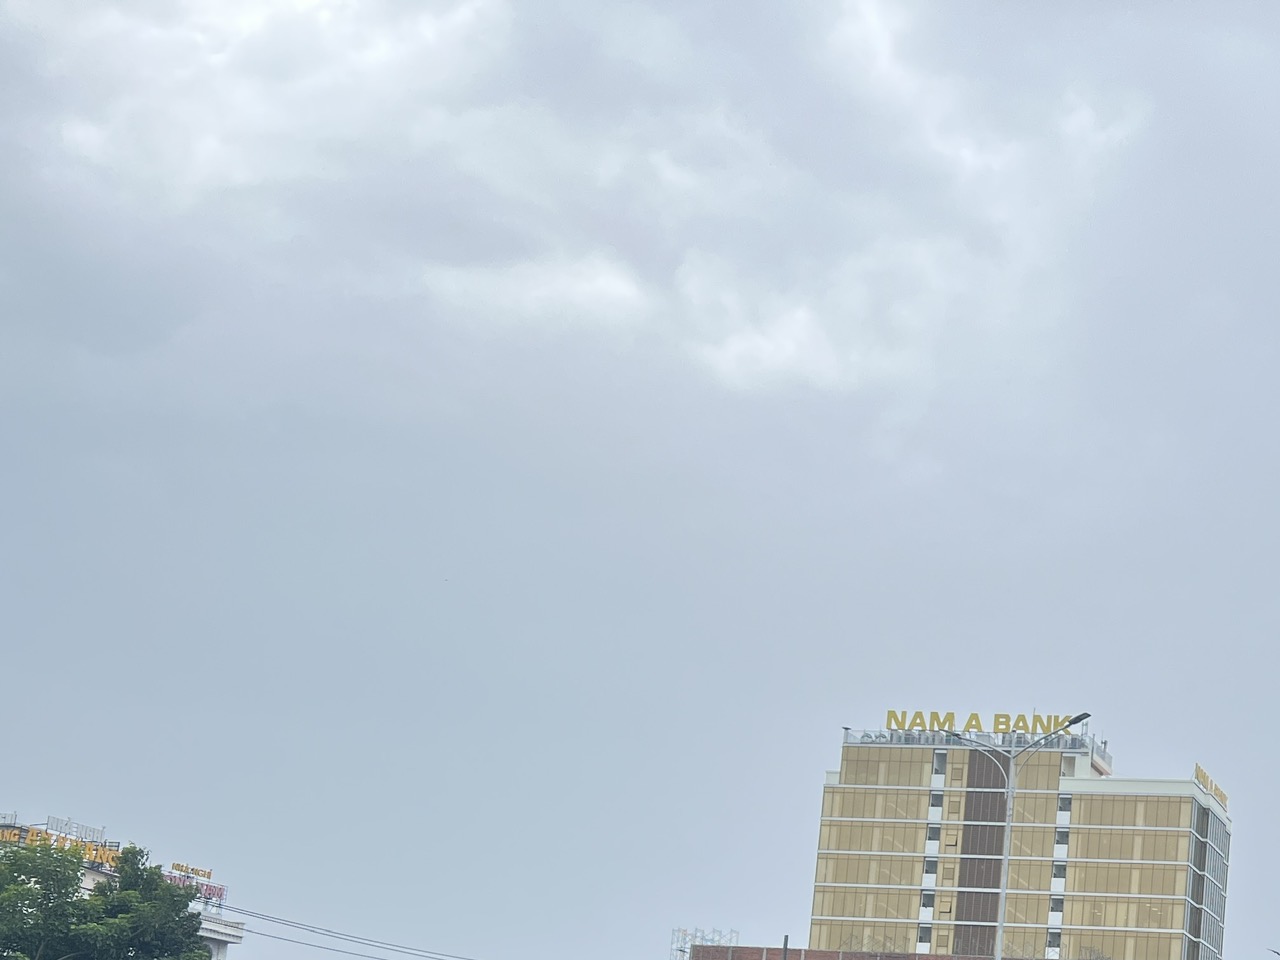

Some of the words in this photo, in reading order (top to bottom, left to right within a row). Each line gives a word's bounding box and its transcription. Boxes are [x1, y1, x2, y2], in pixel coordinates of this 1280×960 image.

[886, 710, 955, 731] NAM
[964, 713, 983, 732] A
[993, 713, 1073, 735] BANK
